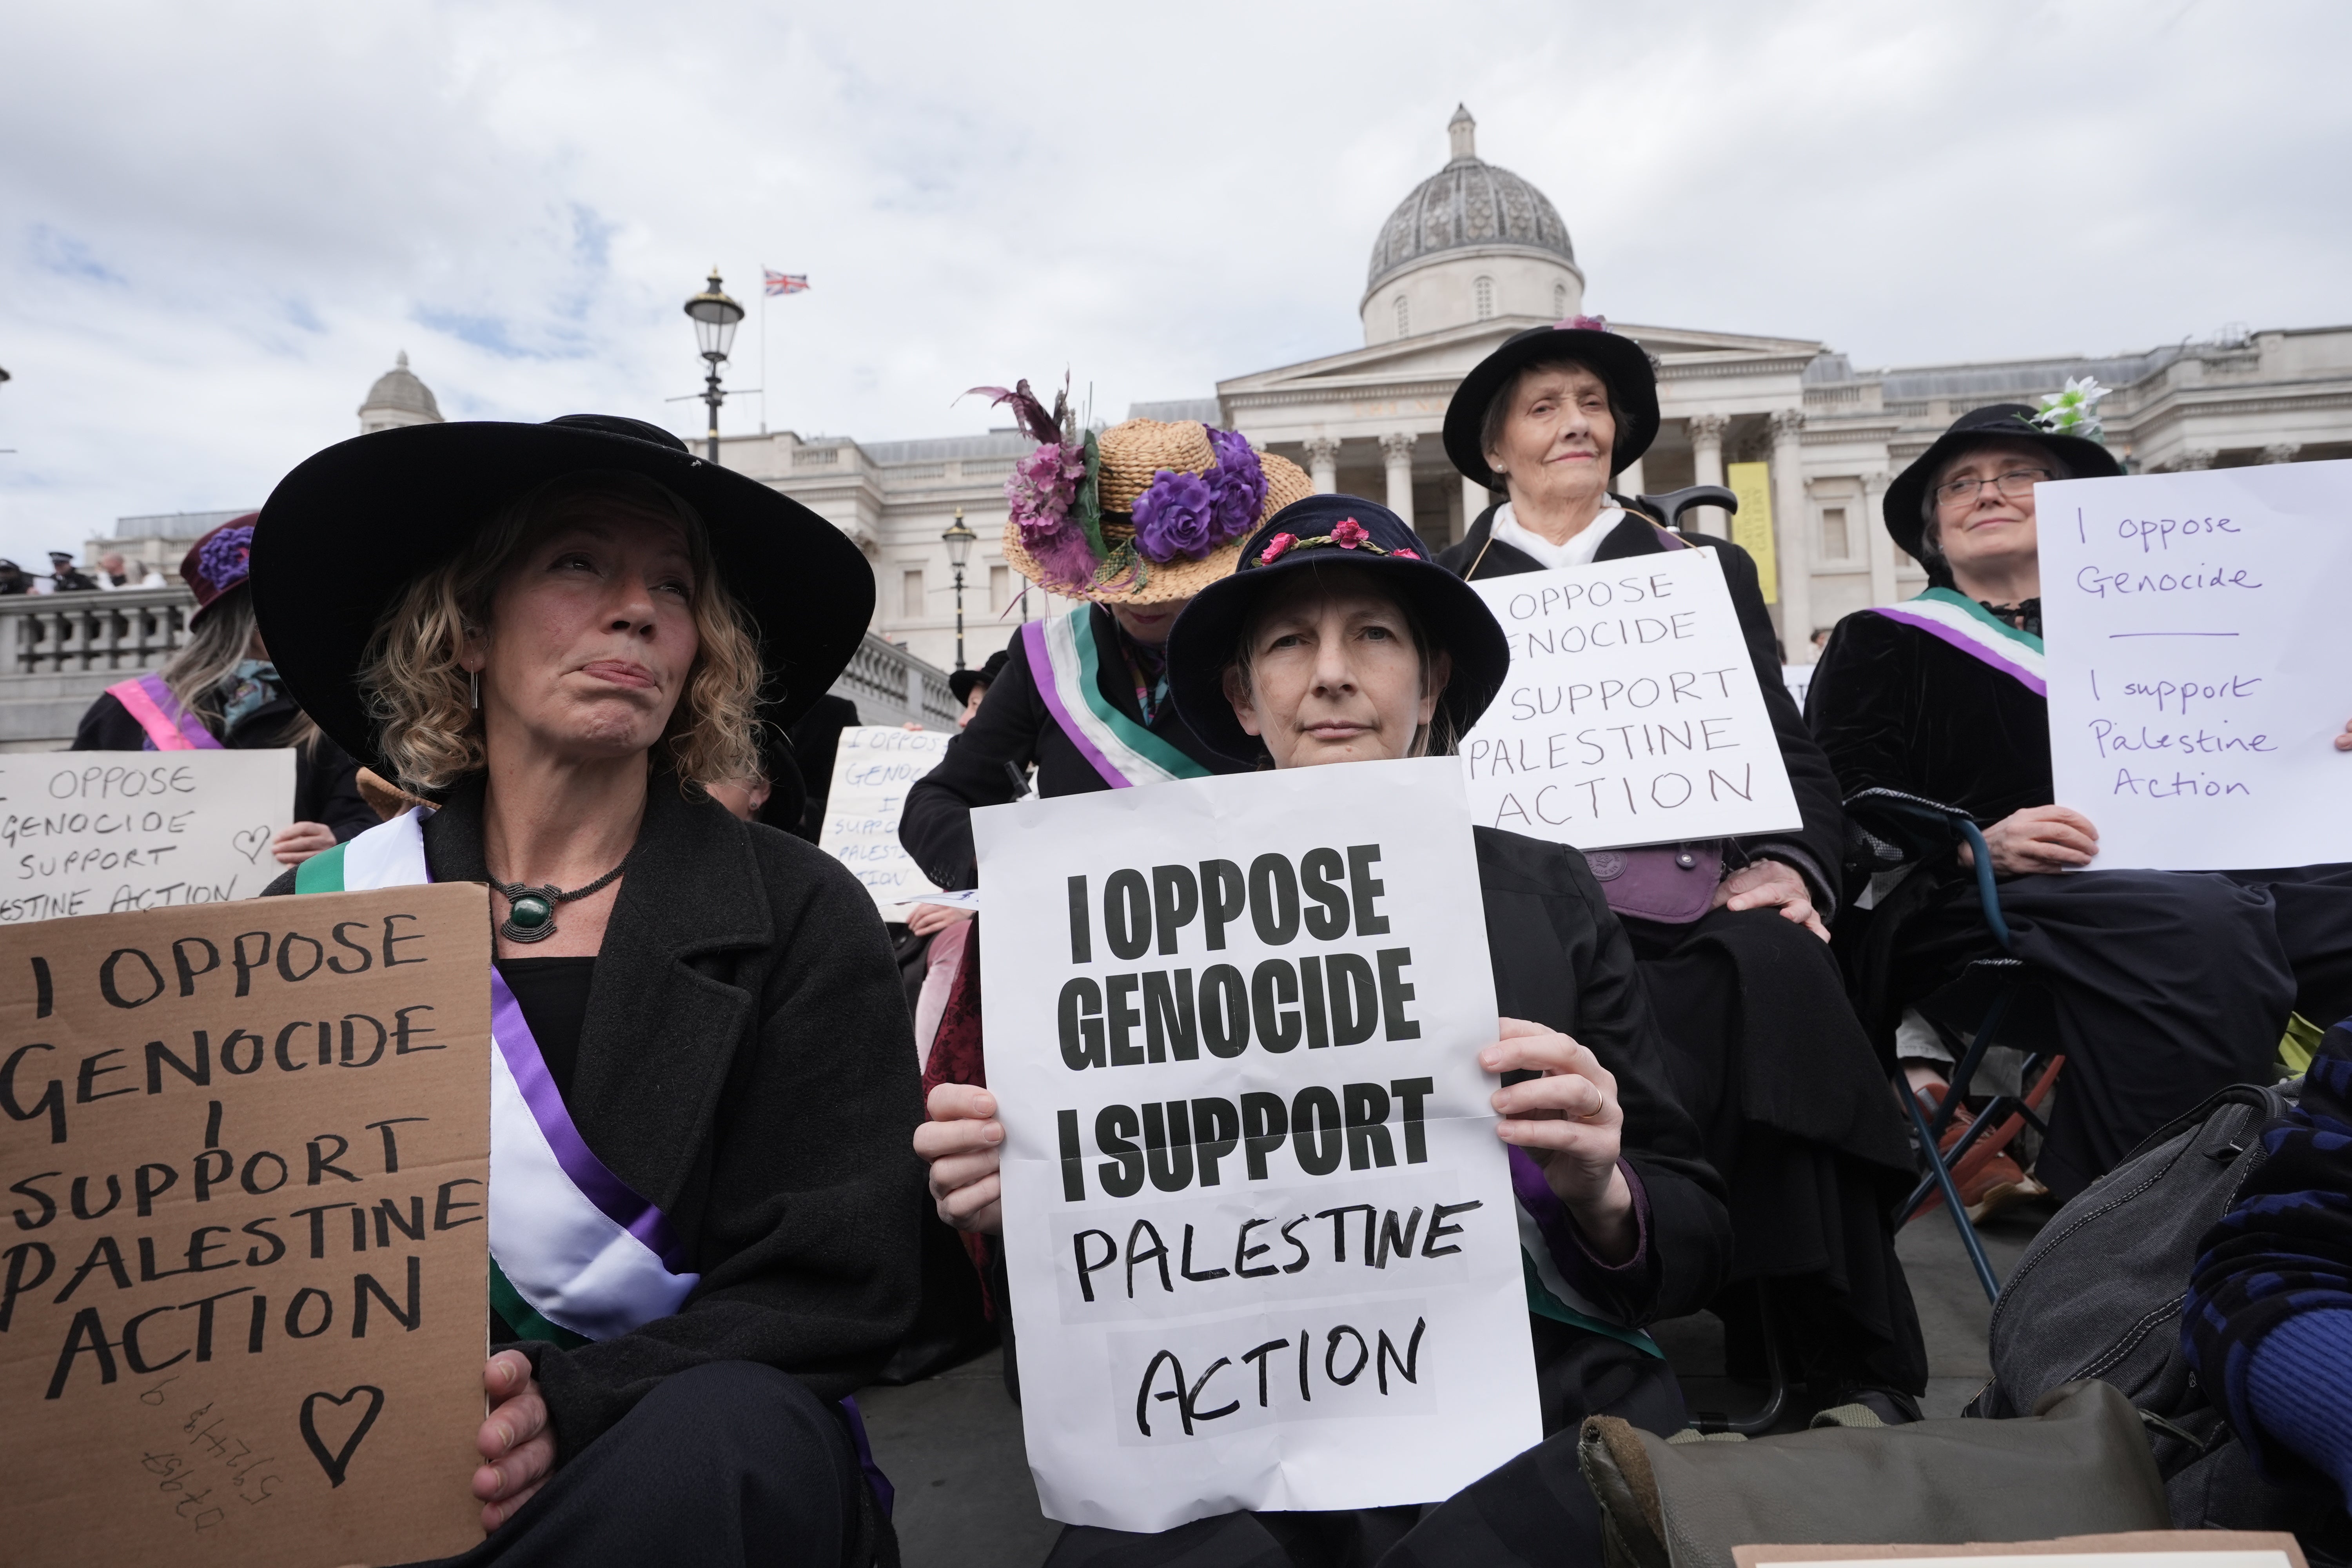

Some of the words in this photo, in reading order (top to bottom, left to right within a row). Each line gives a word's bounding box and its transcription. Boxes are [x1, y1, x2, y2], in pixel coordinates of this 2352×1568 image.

[2078, 507, 2085, 544] I
[2119, 517, 2241, 553] oppose
[1510, 574, 1673, 619] OPPOSE
[2077, 563, 2263, 599] Genocide
[1511, 668, 1738, 720] SUPPORT
[2091, 670, 2100, 701] I
[2124, 675, 2263, 715] support
[848, 728, 867, 748] I
[1471, 718, 1740, 780] PALESTINE
[2089, 719, 2278, 758] Palestine
[49, 766, 196, 799] OPPOSE
[878, 797, 900, 812] I
[1495, 763, 1753, 828] ACTION
[2114, 768, 2250, 798] Action
[1, 810, 195, 849] GENOCIDE
[18, 845, 177, 879] SUPPORT
[109, 874, 238, 913] ACTION
[1067, 875, 1092, 964] I
[1103, 843, 1391, 960] OPPOSE
[31, 957, 53, 1019] I
[99, 915, 428, 1009] OPPOSE
[1057, 947, 1421, 1071] GENOCIDE
[0, 1005, 447, 1143] GENOCIDE
[205, 1101, 223, 1149] I
[1057, 1109, 1086, 1202] I
[1095, 1076, 1434, 1198] SUPPORT
[9, 1117, 430, 1230] SUPPORT
[0, 1179, 484, 1332] PALESTINE
[1073, 1200, 1484, 1302] PALESTINE
[44, 1256, 422, 1399] ACTION
[1136, 1316, 1426, 1437] ACTION
